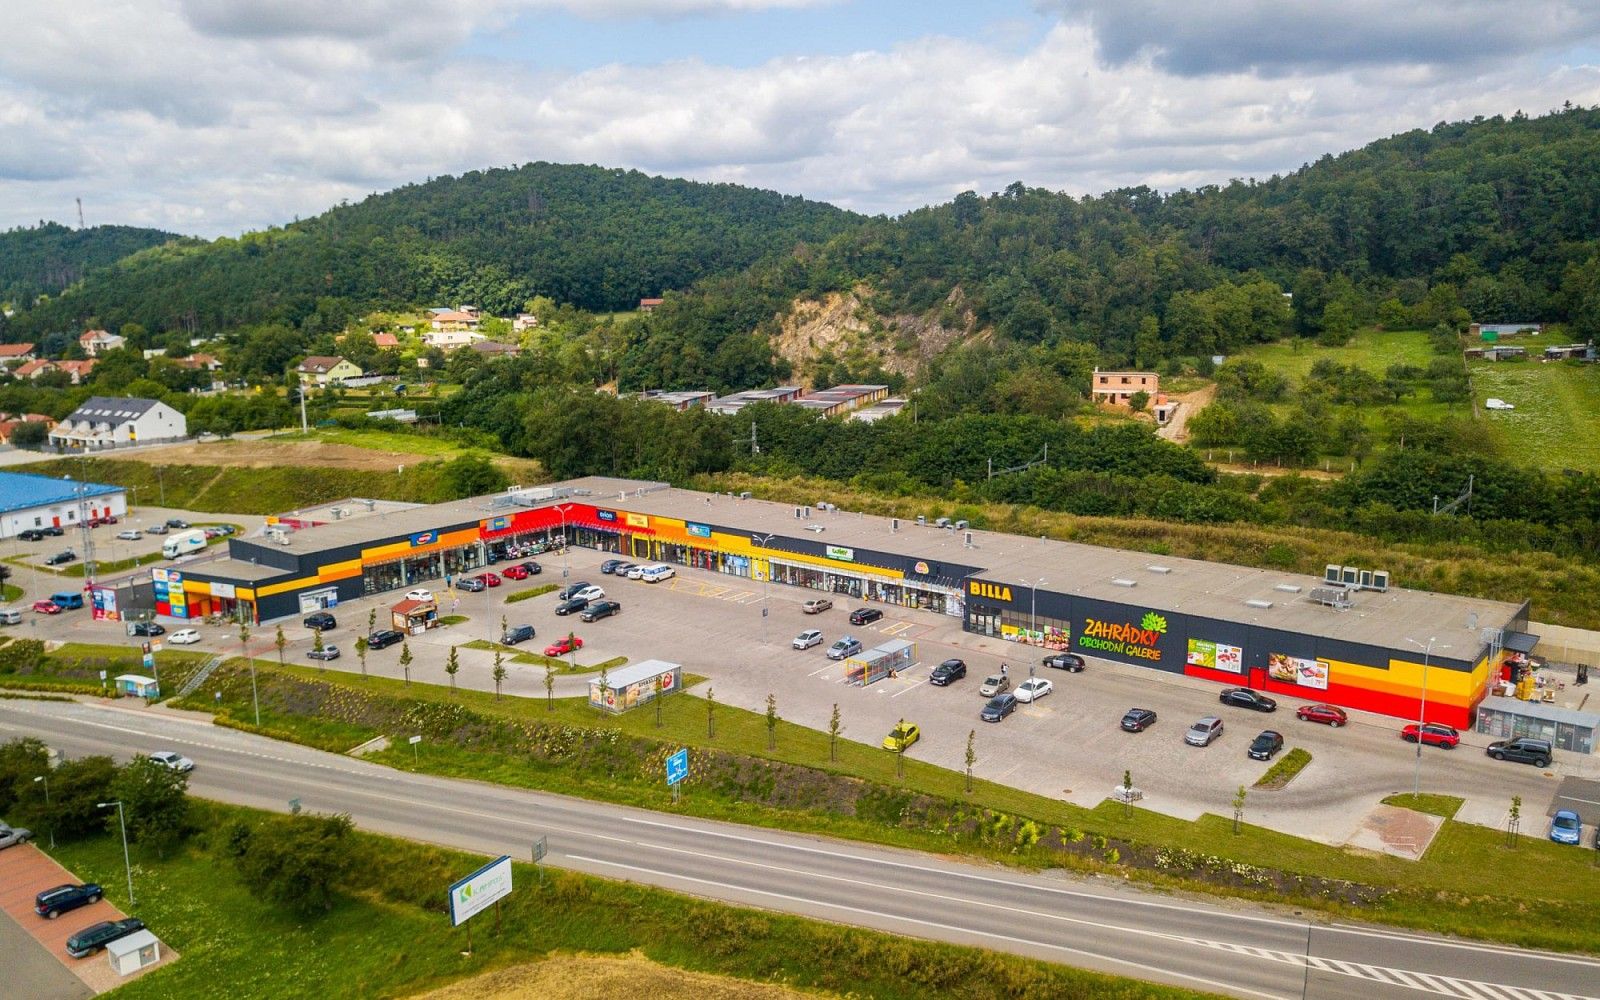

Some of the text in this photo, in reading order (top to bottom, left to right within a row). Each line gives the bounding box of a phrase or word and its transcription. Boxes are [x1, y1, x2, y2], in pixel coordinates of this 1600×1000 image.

[970, 581, 1012, 602] BILLA
[1084, 618, 1160, 647] ZAHRÁDKY
[1079, 636, 1162, 661] OBCHODNÍ GALERIE
